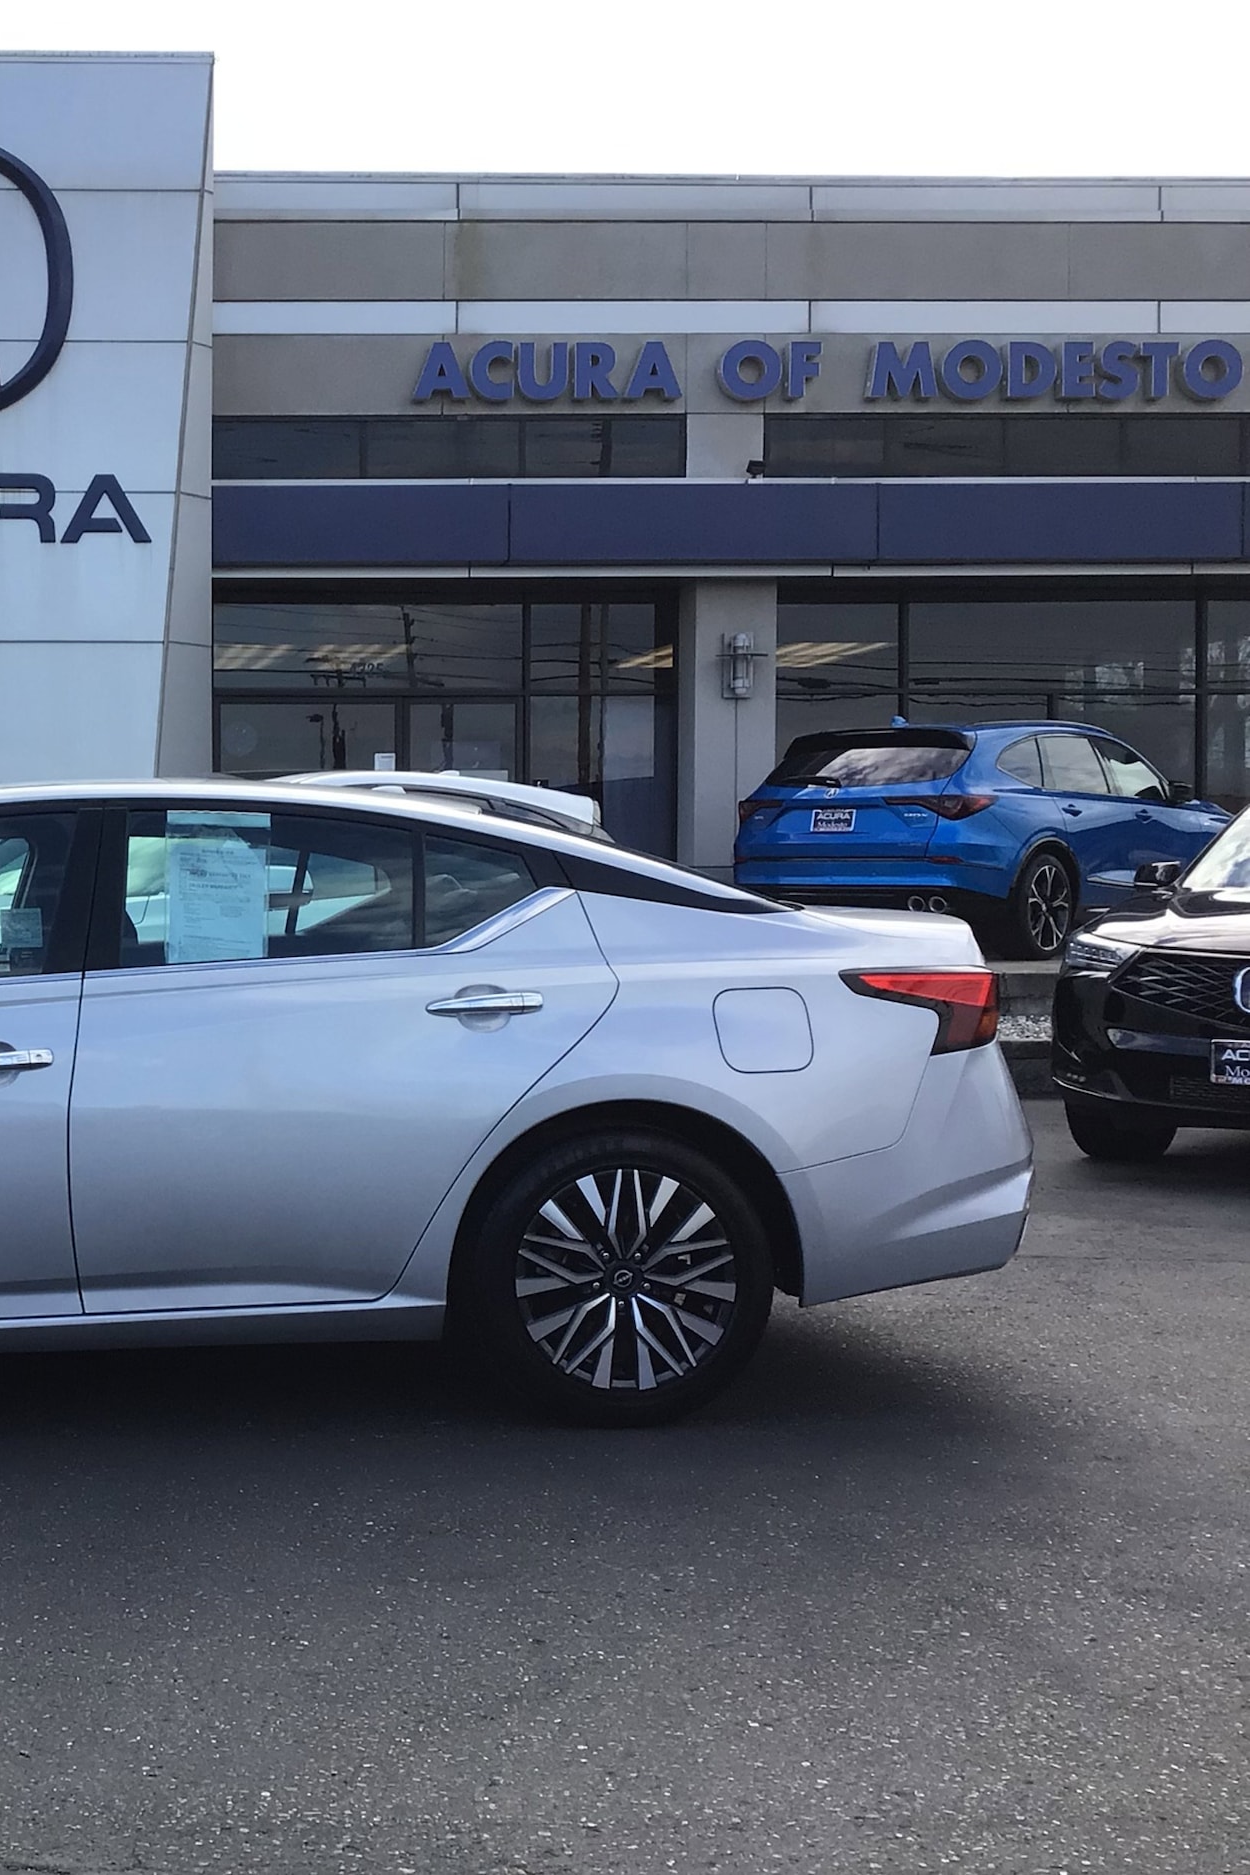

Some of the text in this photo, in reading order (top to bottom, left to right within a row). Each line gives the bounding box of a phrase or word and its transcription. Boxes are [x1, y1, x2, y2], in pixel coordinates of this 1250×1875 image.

[413, 339, 1244, 401] ACURA OF MODESTO
[816, 812, 851, 820] ACURA
